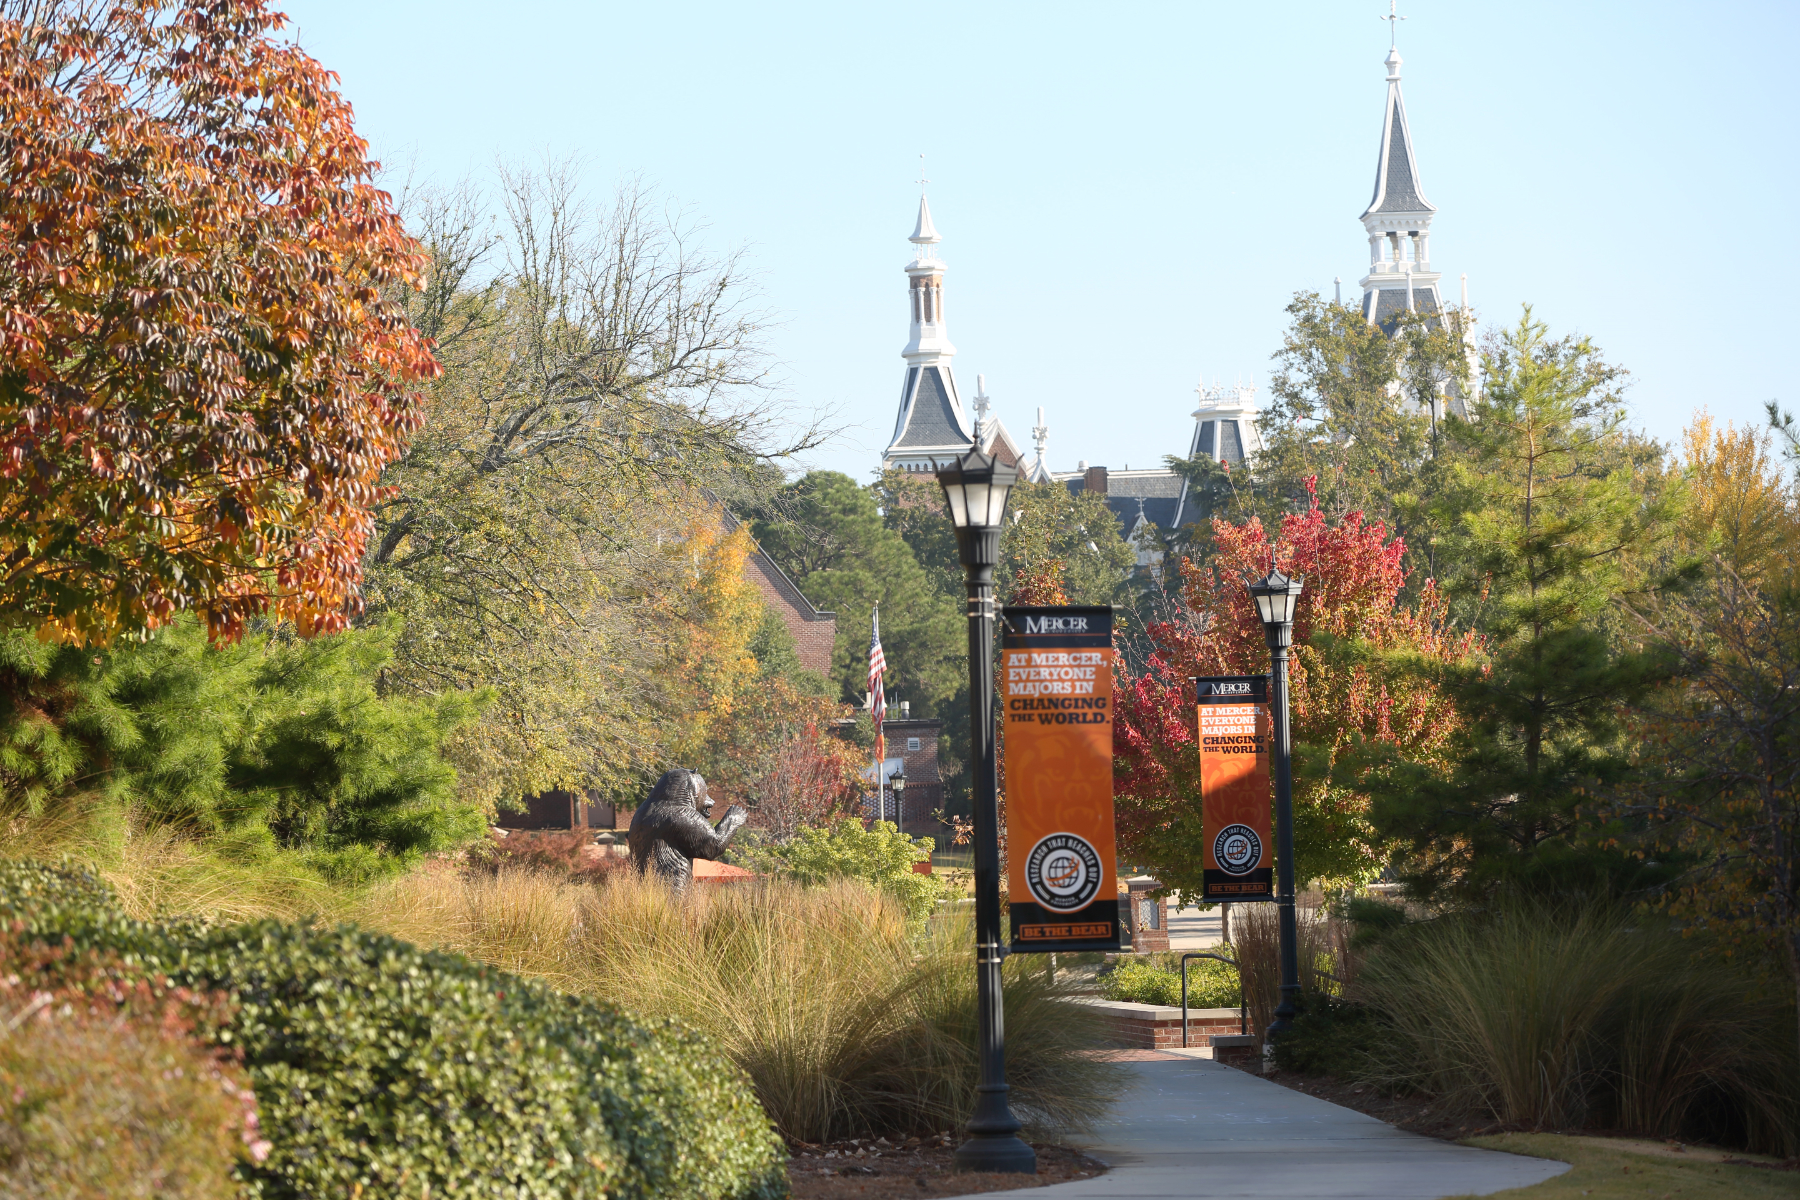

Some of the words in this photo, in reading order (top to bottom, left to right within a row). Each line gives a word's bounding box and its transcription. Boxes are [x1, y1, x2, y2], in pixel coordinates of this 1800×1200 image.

[1025, 616, 1089, 634] MERCER
[1007, 653, 1028, 666] AT
[1030, 652, 1107, 667] MERCER,
[1008, 667, 1096, 681] EVERYONE
[1008, 681, 1072, 698] MAJORS
[1074, 681, 1094, 694] IN
[1211, 683, 1251, 694] MERCER
[1009, 697, 1107, 711] CHANGING
[1200, 708, 1214, 716] AT
[1216, 706, 1264, 716] MERCER,
[1009, 713, 1034, 722] THE
[1037, 712, 1110, 725] WORLD.
[1200, 716, 1256, 726] EVERYONE
[1201, 726, 1242, 736] MAJORS
[1244, 726, 1256, 734] IN
[1202, 736, 1264, 744] CHANGING
[1221, 746, 1268, 754] WORLD.
[1030, 844, 1049, 884] RESEARCH
[1047, 838, 1066, 849] THAT
[1066, 838, 1096, 866] REACHES
[1088, 866, 1098, 882] OUT
[1024, 928, 1042, 937] BE
[1043, 926, 1070, 936] THE
[1072, 925, 1108, 936] BEAR
